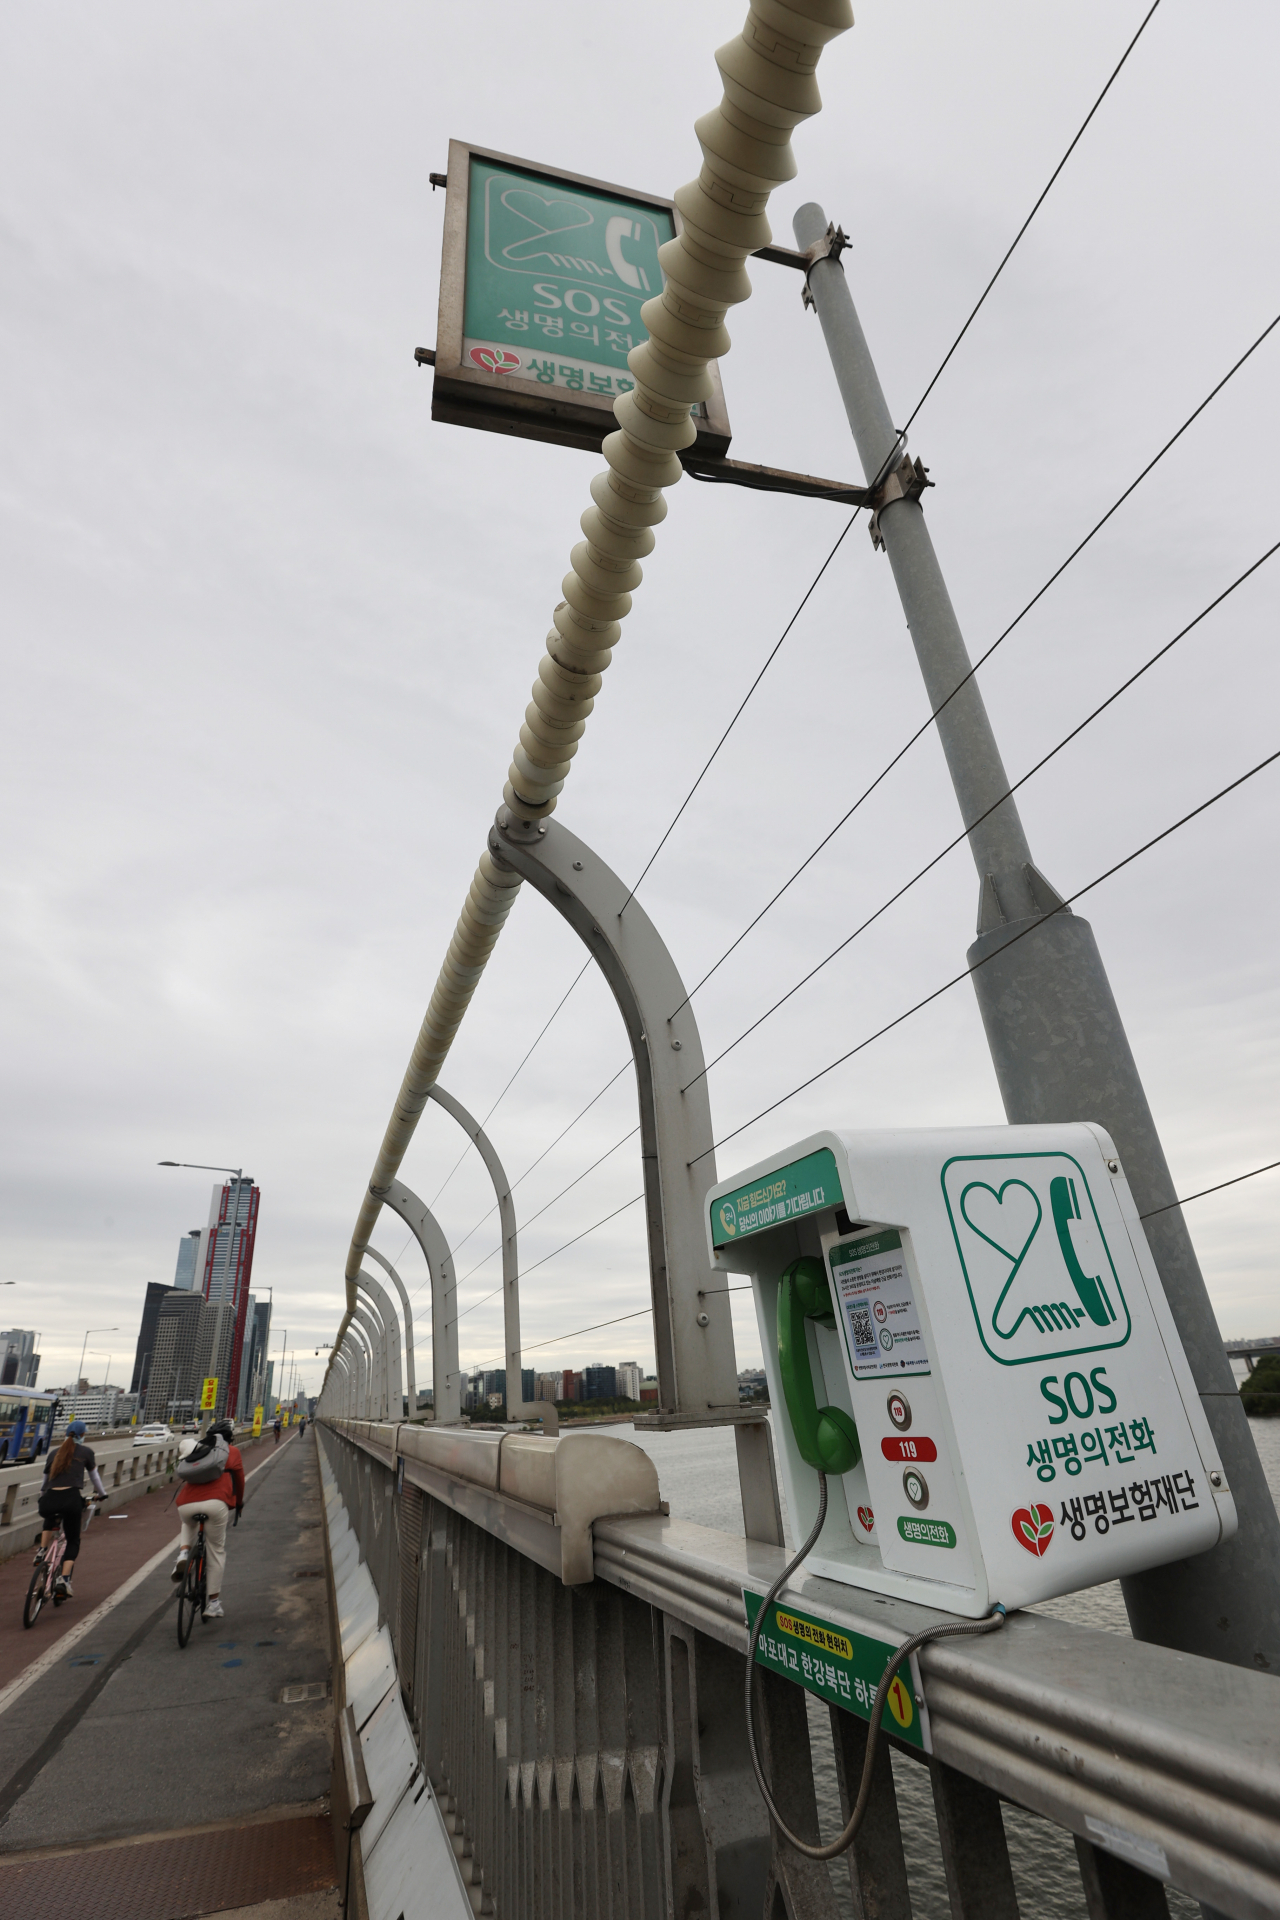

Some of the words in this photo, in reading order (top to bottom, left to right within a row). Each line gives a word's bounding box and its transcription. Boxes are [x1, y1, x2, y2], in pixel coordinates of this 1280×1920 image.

[533, 283, 631, 326] SOS
[497, 307, 649, 354] 생명의전
[736, 1195, 750, 1212] 지금
[749, 1180, 786, 1208] 힘드신가요?
[738, 1211, 758, 1232] 당신의
[758, 1201, 786, 1225] 이야기를
[787, 1187, 825, 1215] 기다립니다
[893, 1407, 902, 1416] 119
[1040, 1367, 1117, 1424] SOS
[899, 1441, 917, 1458] 119
[1026, 1417, 1157, 1483] 생명의전화
[1060, 1470, 1199, 1541] 생명보험재단
[904, 1521, 949, 1544] 생명의전화
[780, 1615, 793, 1630] SOS
[826, 1633, 849, 1656] 현위치
[758, 1633, 800, 1672] 마포대교
[801, 1651, 851, 1700] 한강북단
[893, 1682, 905, 1720] 1
